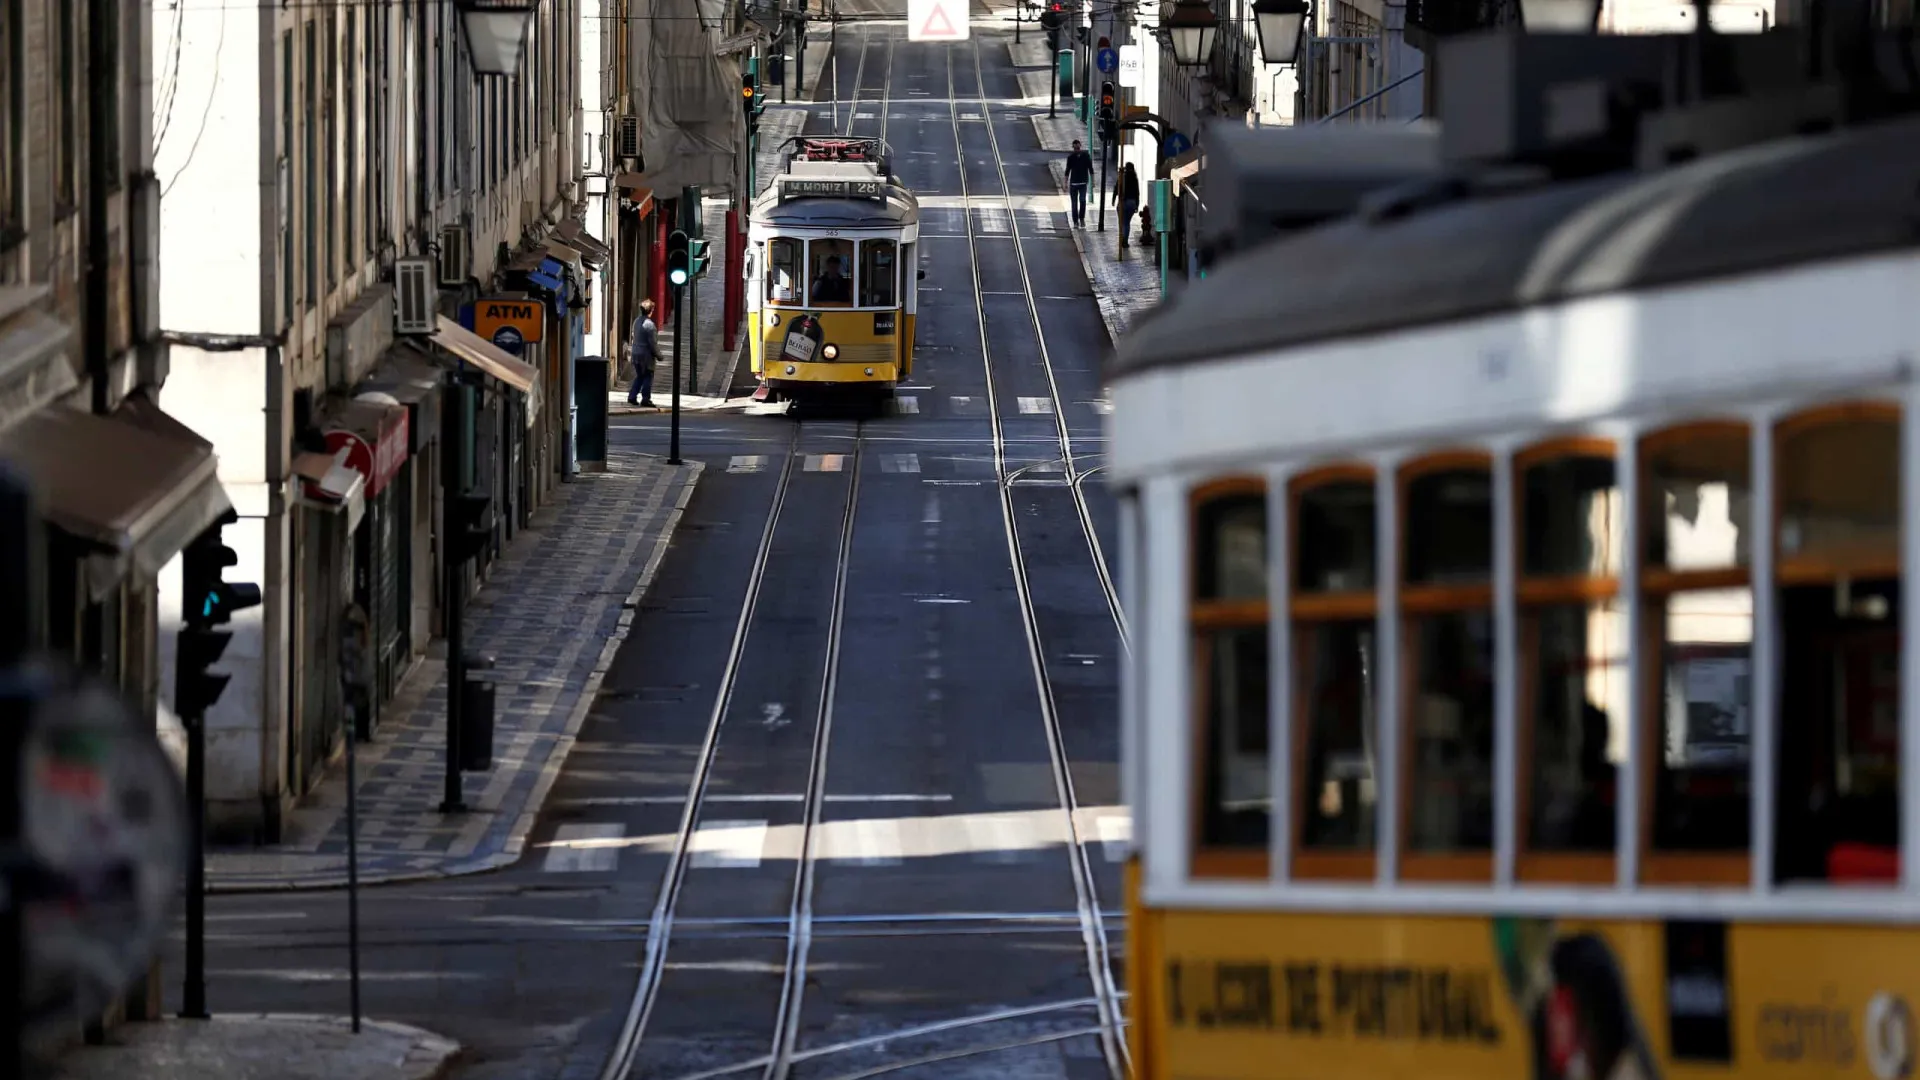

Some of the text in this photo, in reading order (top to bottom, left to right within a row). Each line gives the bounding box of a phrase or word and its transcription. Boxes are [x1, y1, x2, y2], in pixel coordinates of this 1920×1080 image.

[804, 182, 841, 191] MONIZ
[857, 183, 876, 193] 28
[485, 305, 532, 319] ATM
